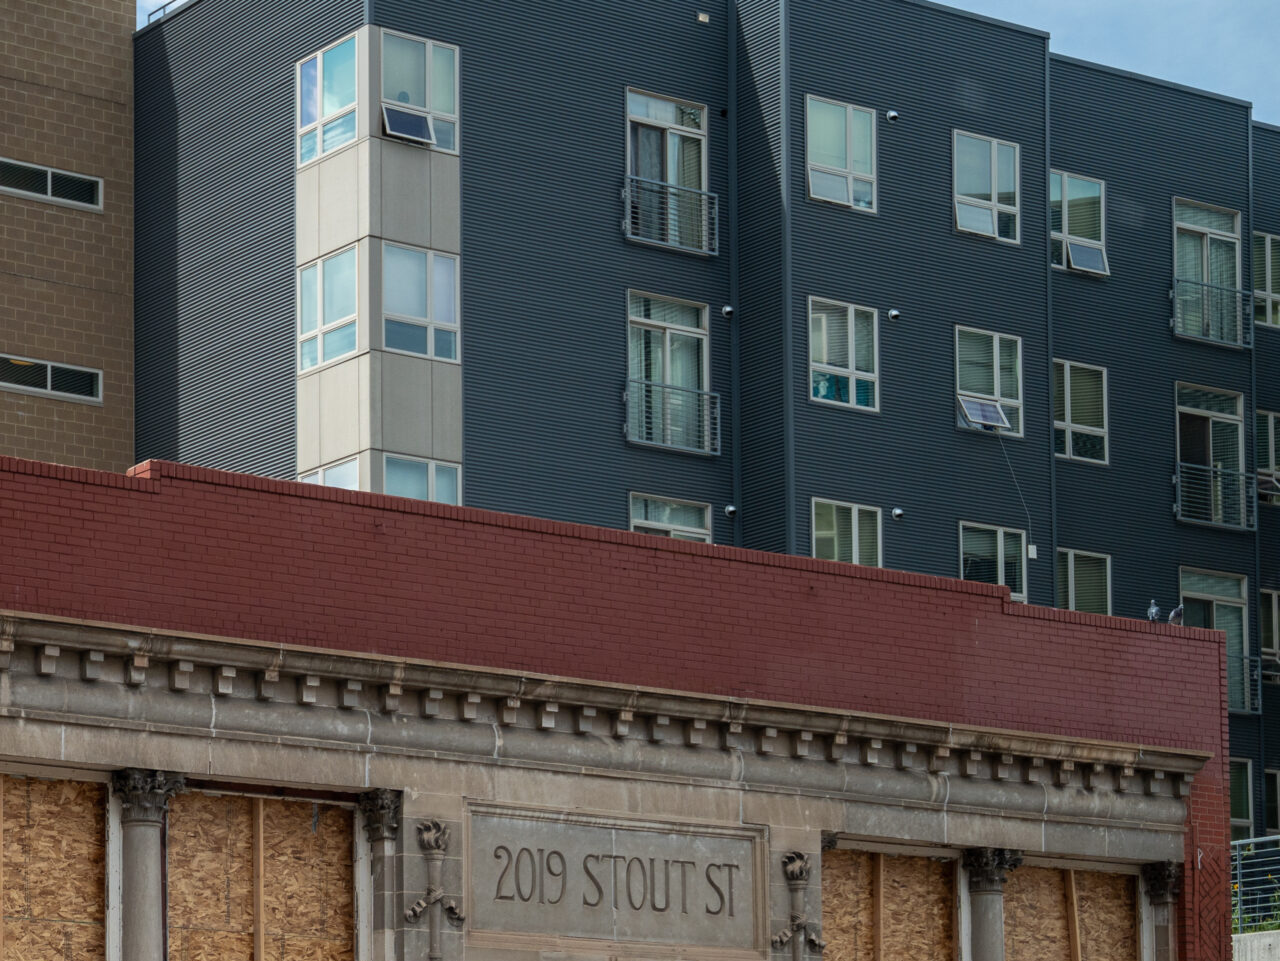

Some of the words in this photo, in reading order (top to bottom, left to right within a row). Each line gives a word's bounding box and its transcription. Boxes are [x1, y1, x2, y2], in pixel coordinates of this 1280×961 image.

[493, 845, 567, 905] 2019
[583, 854, 697, 915] STOUT
[705, 863, 740, 917] ST
